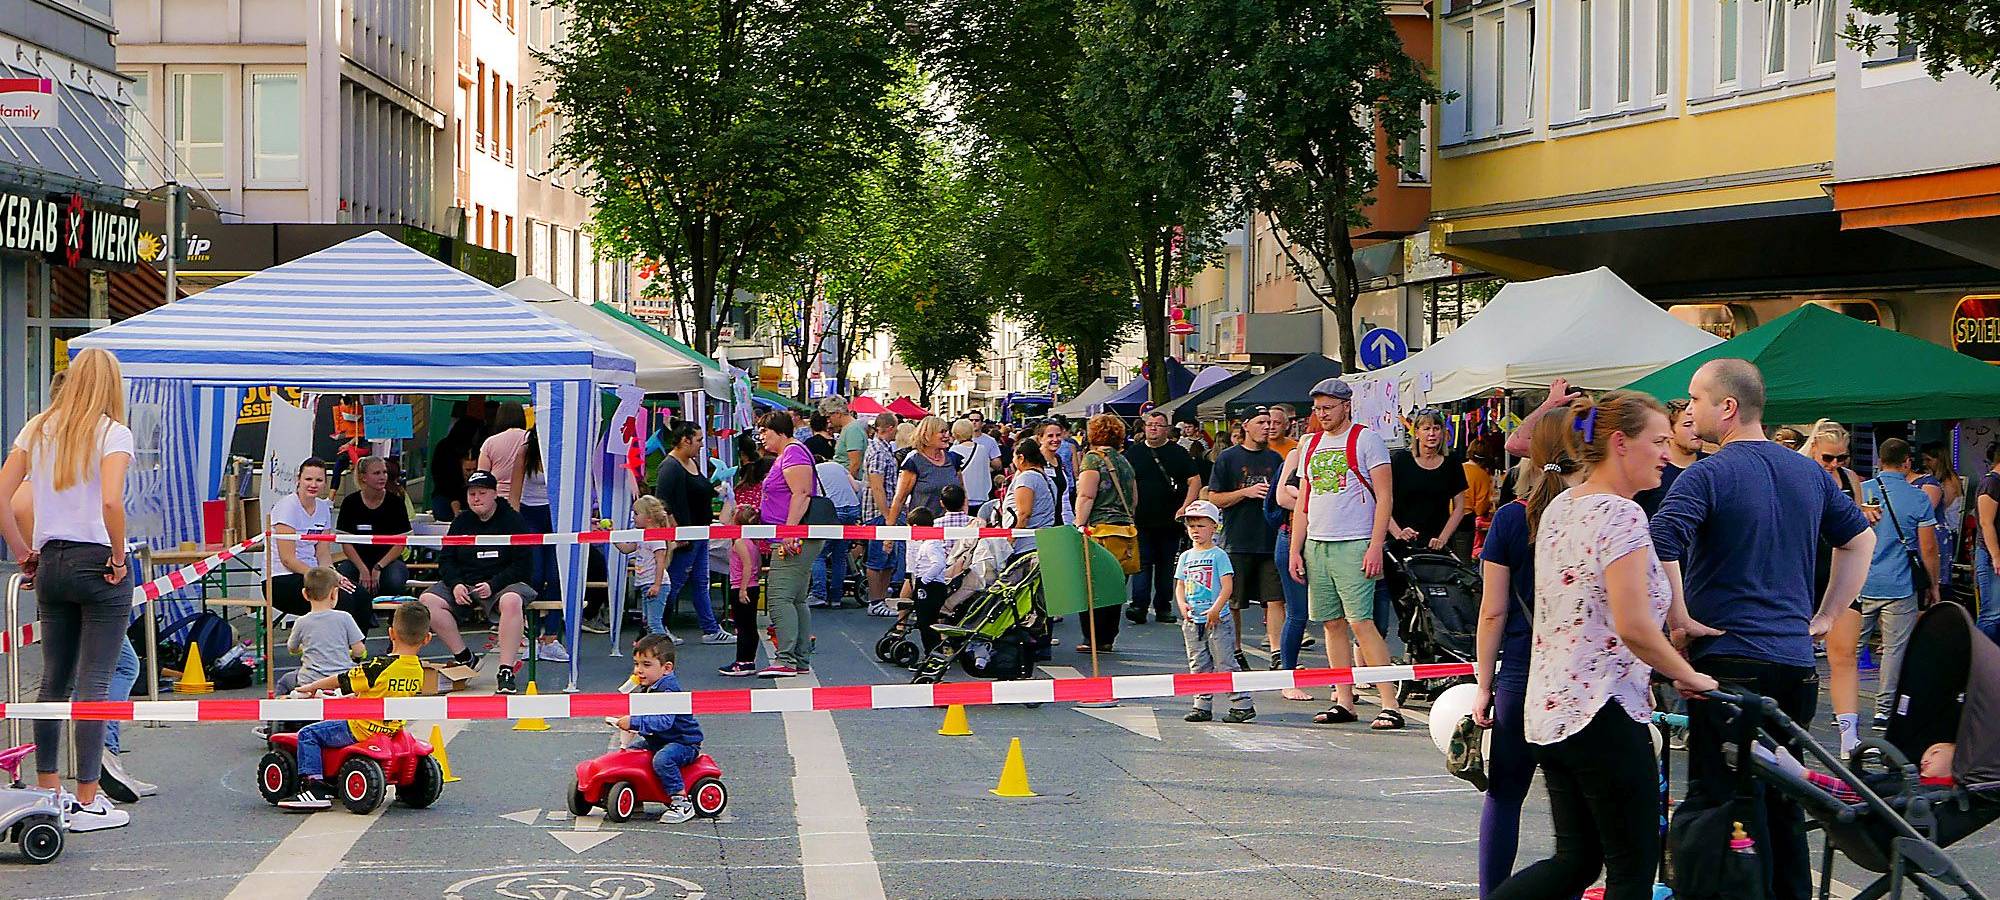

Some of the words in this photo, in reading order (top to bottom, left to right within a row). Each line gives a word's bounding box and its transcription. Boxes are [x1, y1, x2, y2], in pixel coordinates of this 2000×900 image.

[0, 104, 40, 120] family
[91, 210, 139, 264] WERK
[1956, 317, 2000, 343] SPIEL
[388, 679, 420, 691] REUS
